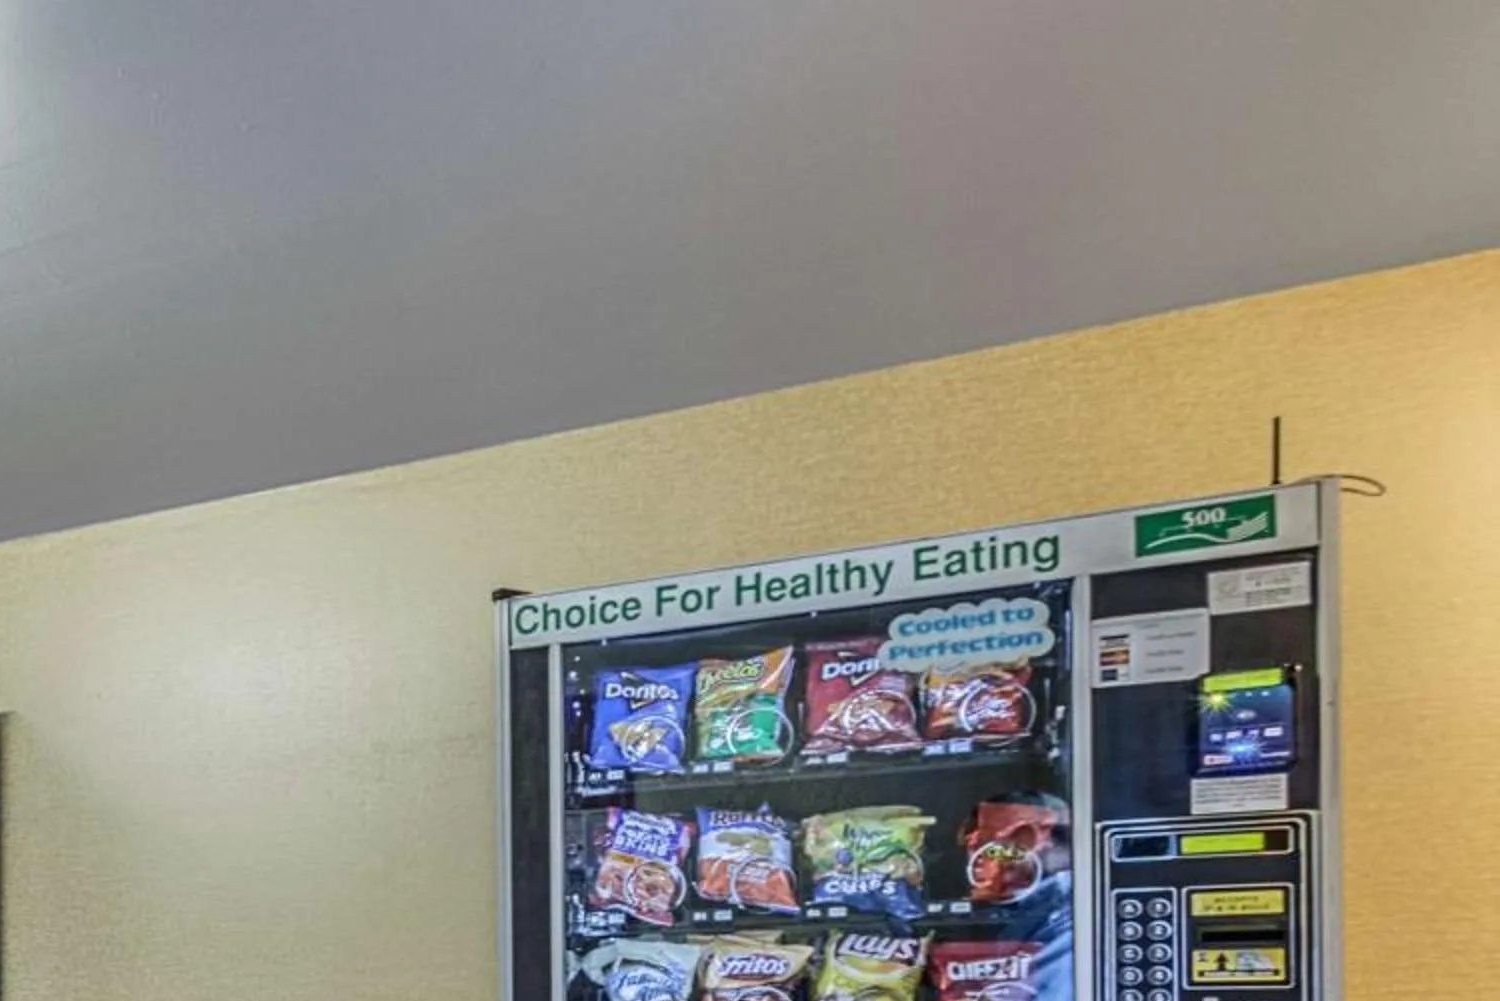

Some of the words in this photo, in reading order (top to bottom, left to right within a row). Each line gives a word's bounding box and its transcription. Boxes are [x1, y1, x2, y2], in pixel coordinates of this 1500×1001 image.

[1180, 507, 1226, 528] 500
[514, 594, 643, 636] Choice
[655, 583, 722, 618] For
[734, 558, 895, 607] Healthy
[912, 534, 1061, 582] Eating
[897, 609, 996, 638] Cooled
[1001, 606, 1036, 624] to
[887, 630, 1044, 662] Perfection
[820, 657, 879, 681] Dori
[604, 682, 680, 700] Doritos
[717, 952, 789, 976] Fritos
